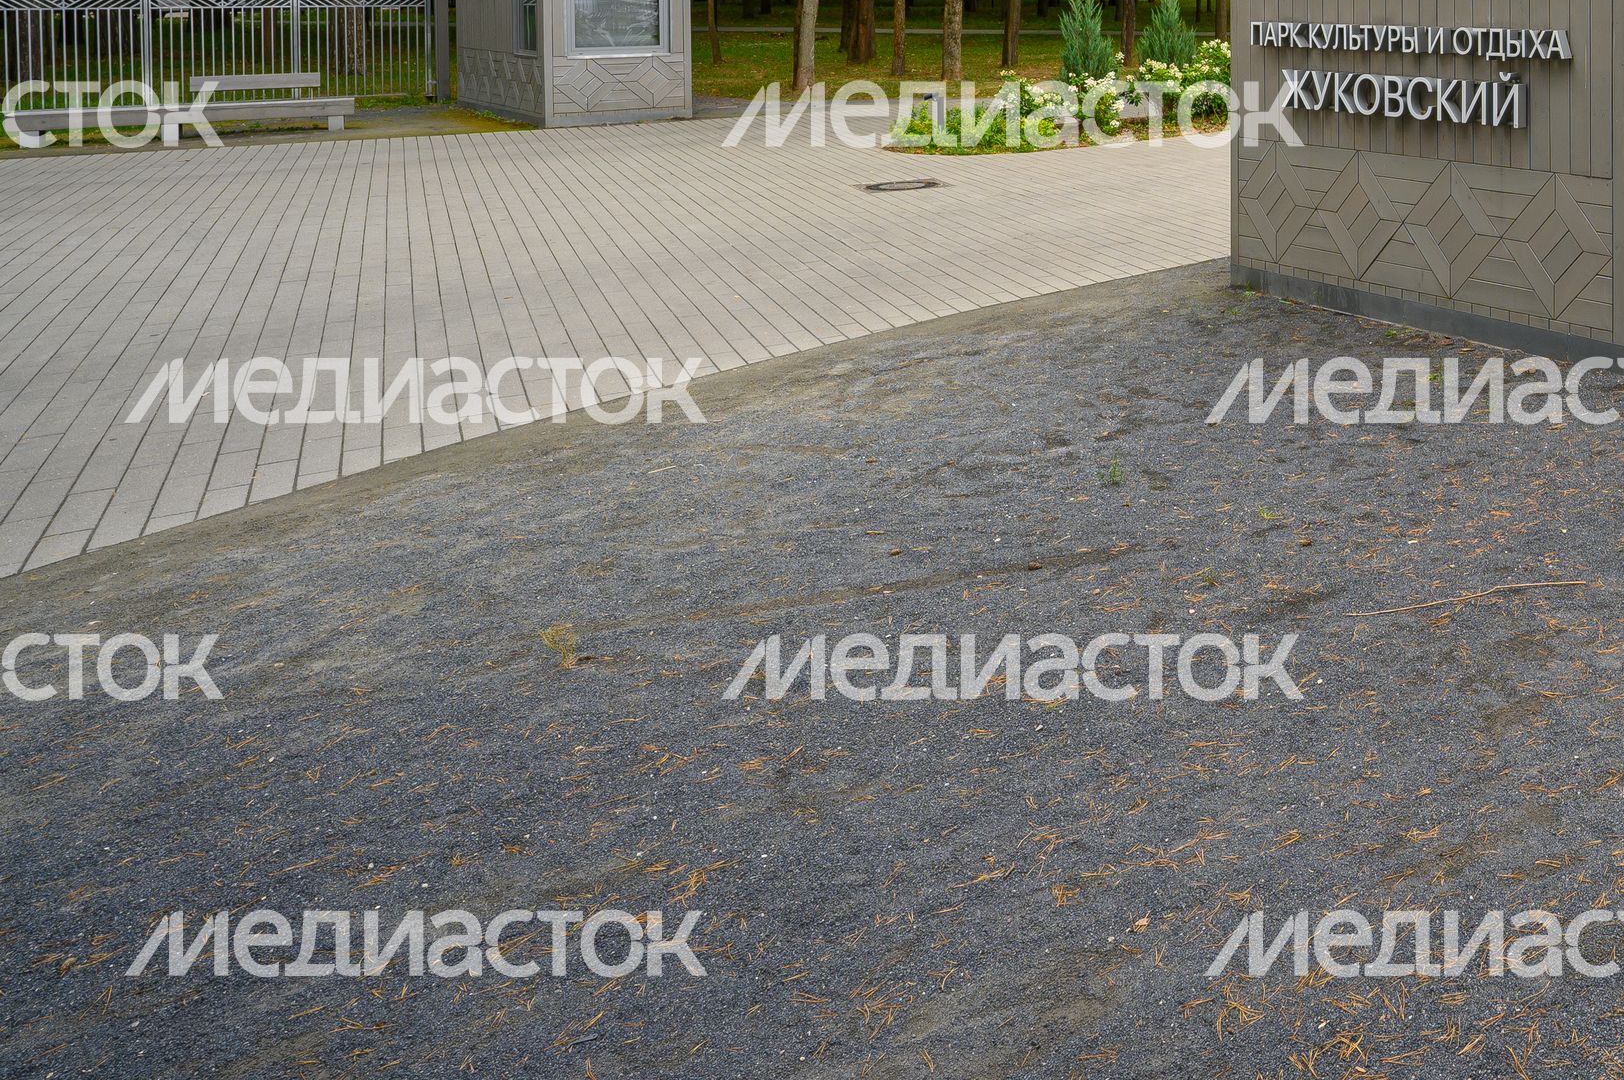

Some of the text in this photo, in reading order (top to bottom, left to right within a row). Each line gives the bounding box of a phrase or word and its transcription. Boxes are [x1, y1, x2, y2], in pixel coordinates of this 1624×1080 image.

[1250, 21, 1571, 61] ПАРК КУЛЬТУРЫ И ОТДЫХА
[1282, 69, 1523, 129] ЖУКОВСКИЙ
